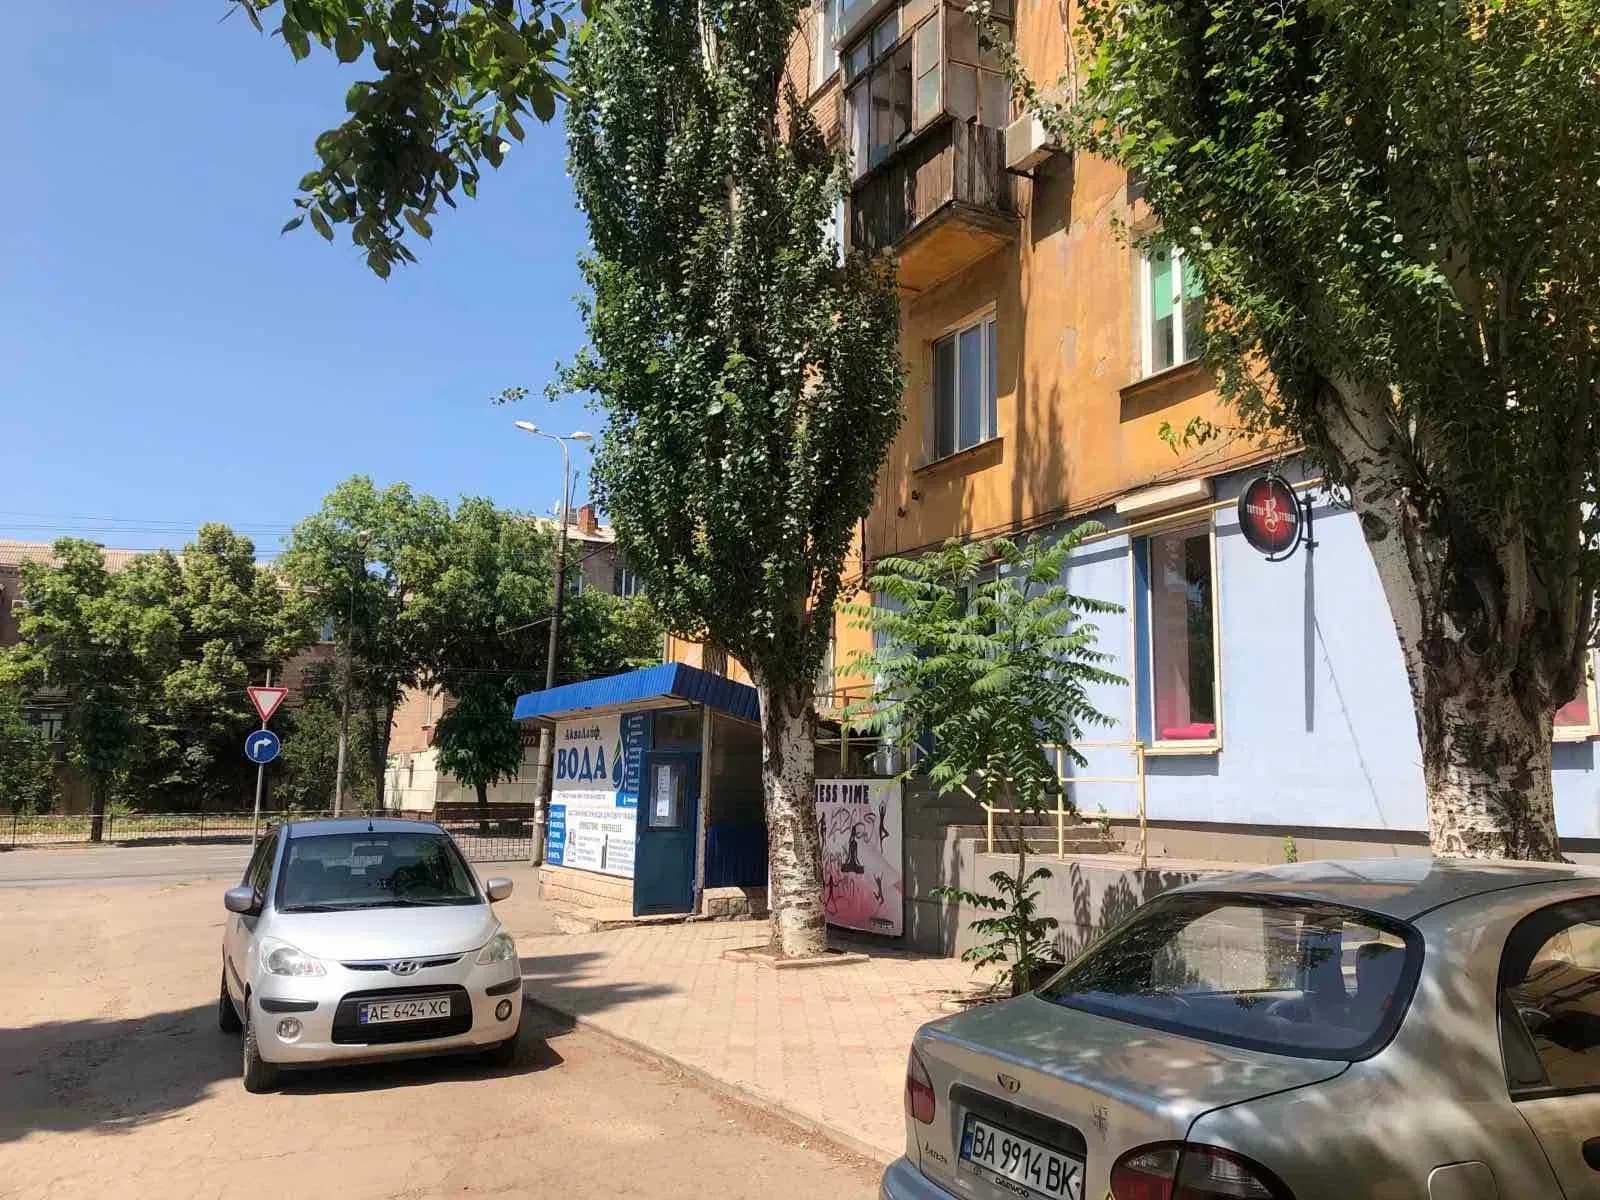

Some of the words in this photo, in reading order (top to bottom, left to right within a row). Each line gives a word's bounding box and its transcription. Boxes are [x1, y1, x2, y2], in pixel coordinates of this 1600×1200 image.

[556, 745, 607, 783] ВОДА
[842, 784, 869, 804] TIME
[369, 1005, 389, 1021] AE
[393, 1002, 425, 1018] 6424
[428, 1000, 448, 1015] XC
[971, 1126, 996, 1165] BA
[1000, 1137, 1042, 1185] 9914
[1046, 1156, 1077, 1200] BK
